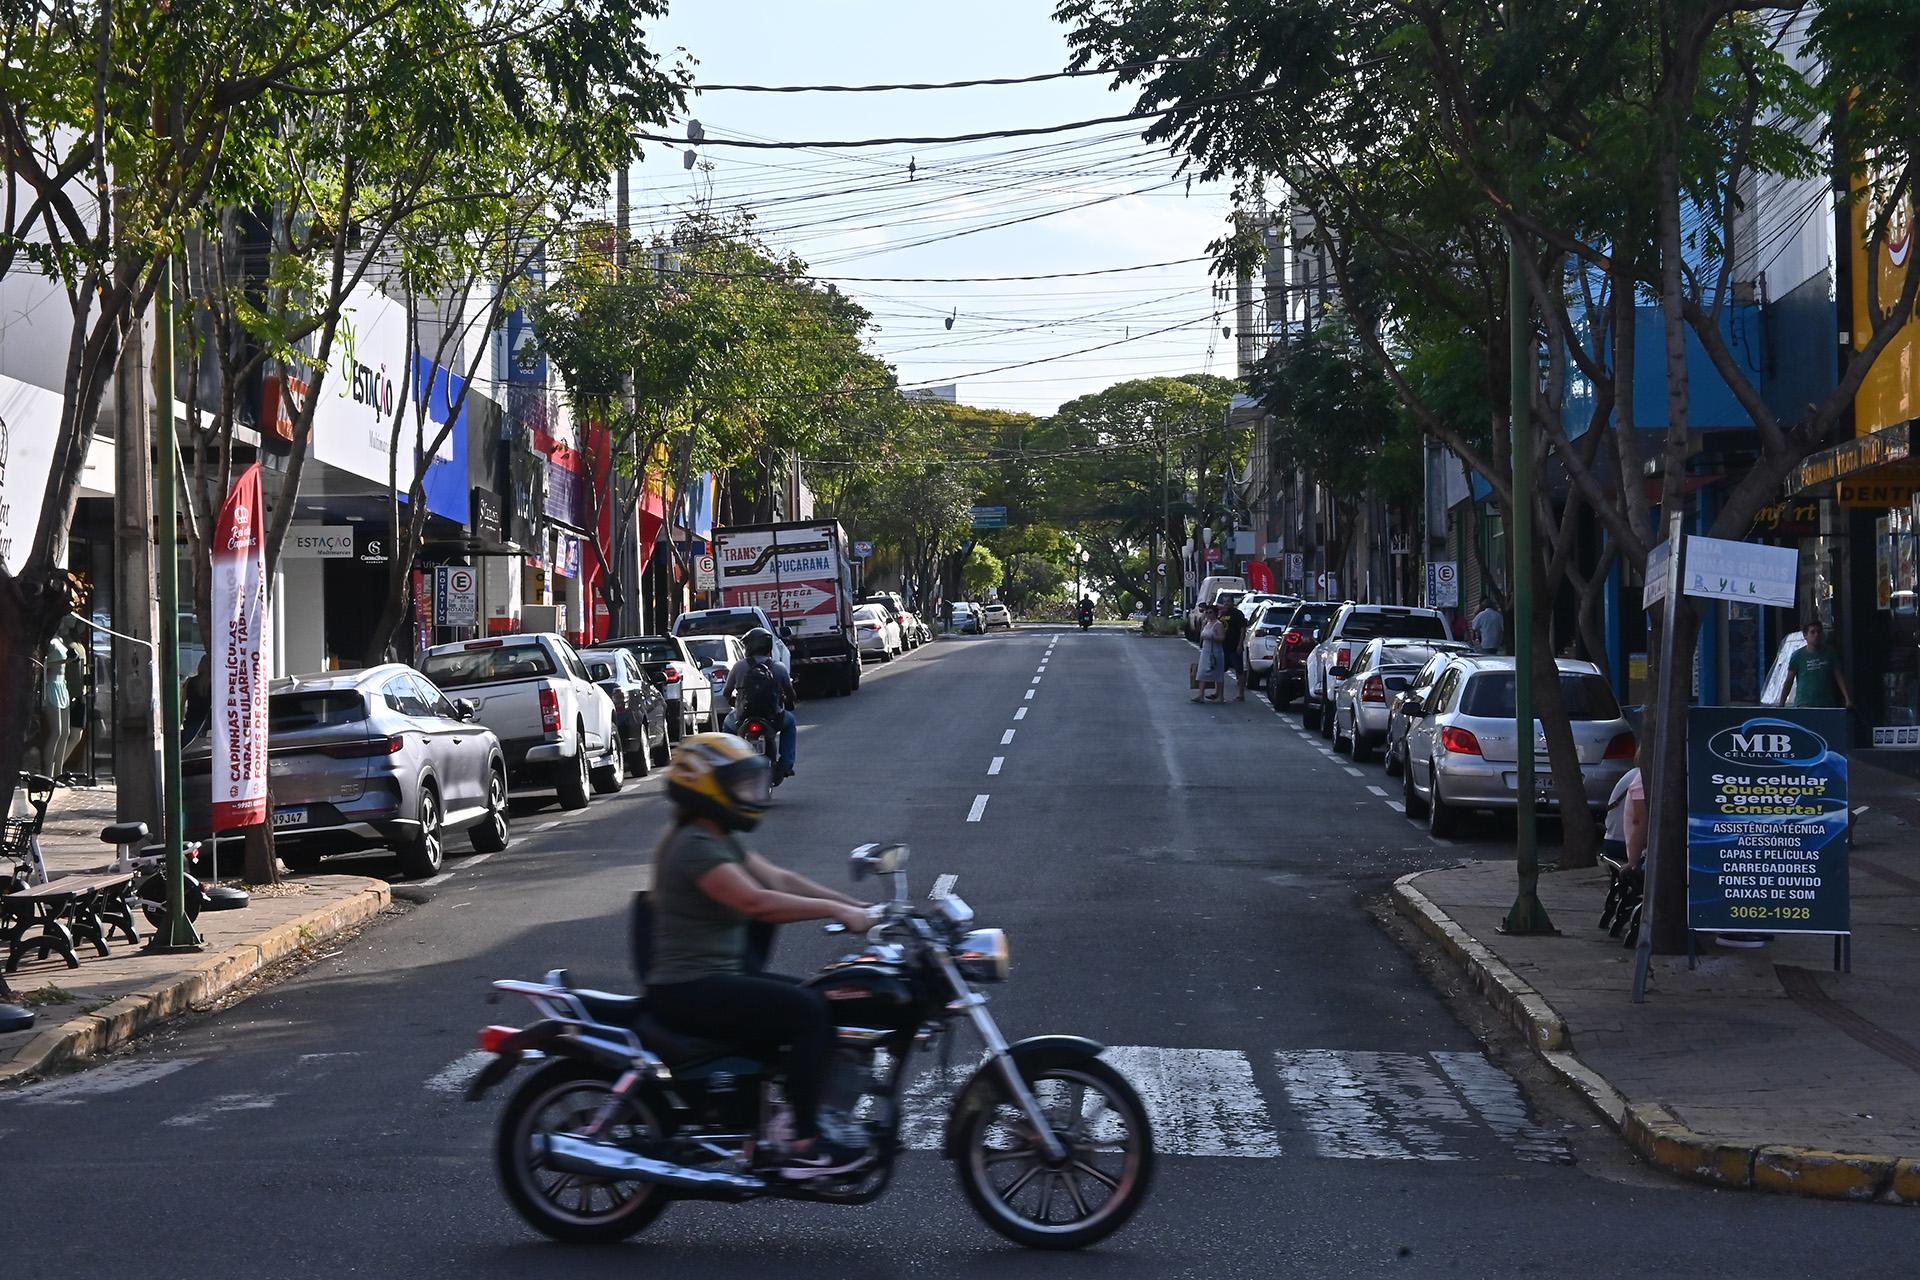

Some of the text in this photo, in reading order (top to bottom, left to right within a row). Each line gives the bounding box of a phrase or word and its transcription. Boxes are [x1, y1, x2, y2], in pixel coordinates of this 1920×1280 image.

[353, 359, 393, 424] ESTAÇÃO
[1843, 486, 1911, 501] DENTI
[297, 534, 351, 550] ESTAÇÃO
[723, 547, 756, 562] TRANS
[769, 557, 830, 574] APUCARANA
[1442, 569, 1450, 578] E
[457, 576, 467, 588] E
[438, 571, 446, 622] ROTATIVO
[764, 589, 812, 600] ENTREGA
[251, 651, 261, 707] OUVIDO
[226, 620, 241, 782] CAPINHAS E PELÍCULAS
[238, 662, 251, 739] CELULARES
[255, 719, 262, 733] DE
[1730, 733, 1792, 752] MB
[1724, 751, 1796, 759] CELULARES
[243, 743, 252, 781] PARA
[1711, 774, 1828, 786] Seu celular
[1722, 784, 1826, 796] Quebrou?
[1714, 794, 1727, 803] a
[1720, 804, 1824, 815] Conserta!
[272, 813, 302, 825] W9J47
[1713, 823, 1825, 834] ASSISTÊNCIA TÉCNICA
[1738, 836, 1801, 847] ACESSÓRIOS
[1720, 848, 1819, 860] CAPAS E PELÍCULAS
[1723, 863, 1816, 873] CARREGADORES
[1718, 876, 1821, 887] FONES DE OUVIDO
[1724, 889, 1815, 899] CAIXAS DE SOM
[1730, 906, 1810, 919] 3062-1928
